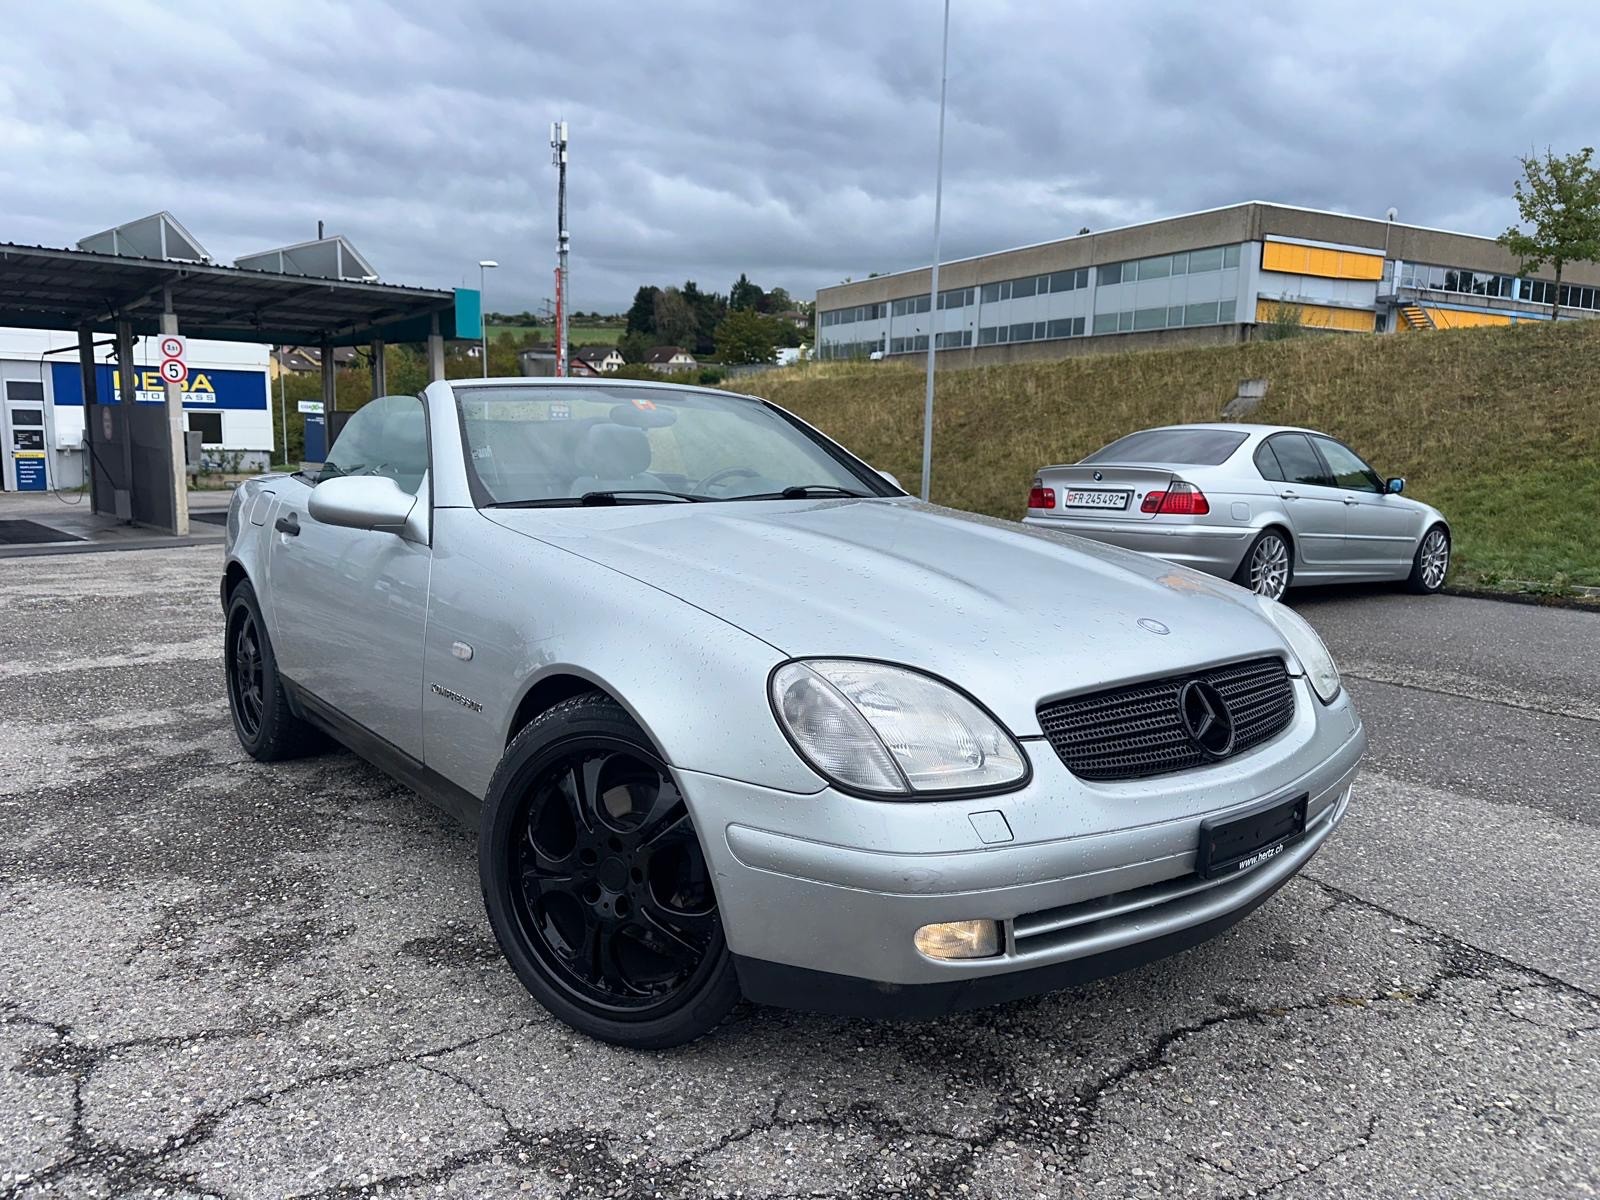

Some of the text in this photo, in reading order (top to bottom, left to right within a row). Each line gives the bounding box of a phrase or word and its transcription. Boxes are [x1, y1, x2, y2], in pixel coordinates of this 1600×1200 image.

[113, 371, 214, 393] DEA
[169, 364, 179, 378] 5
[1239, 842, 1284, 869] www.hertz.ch
